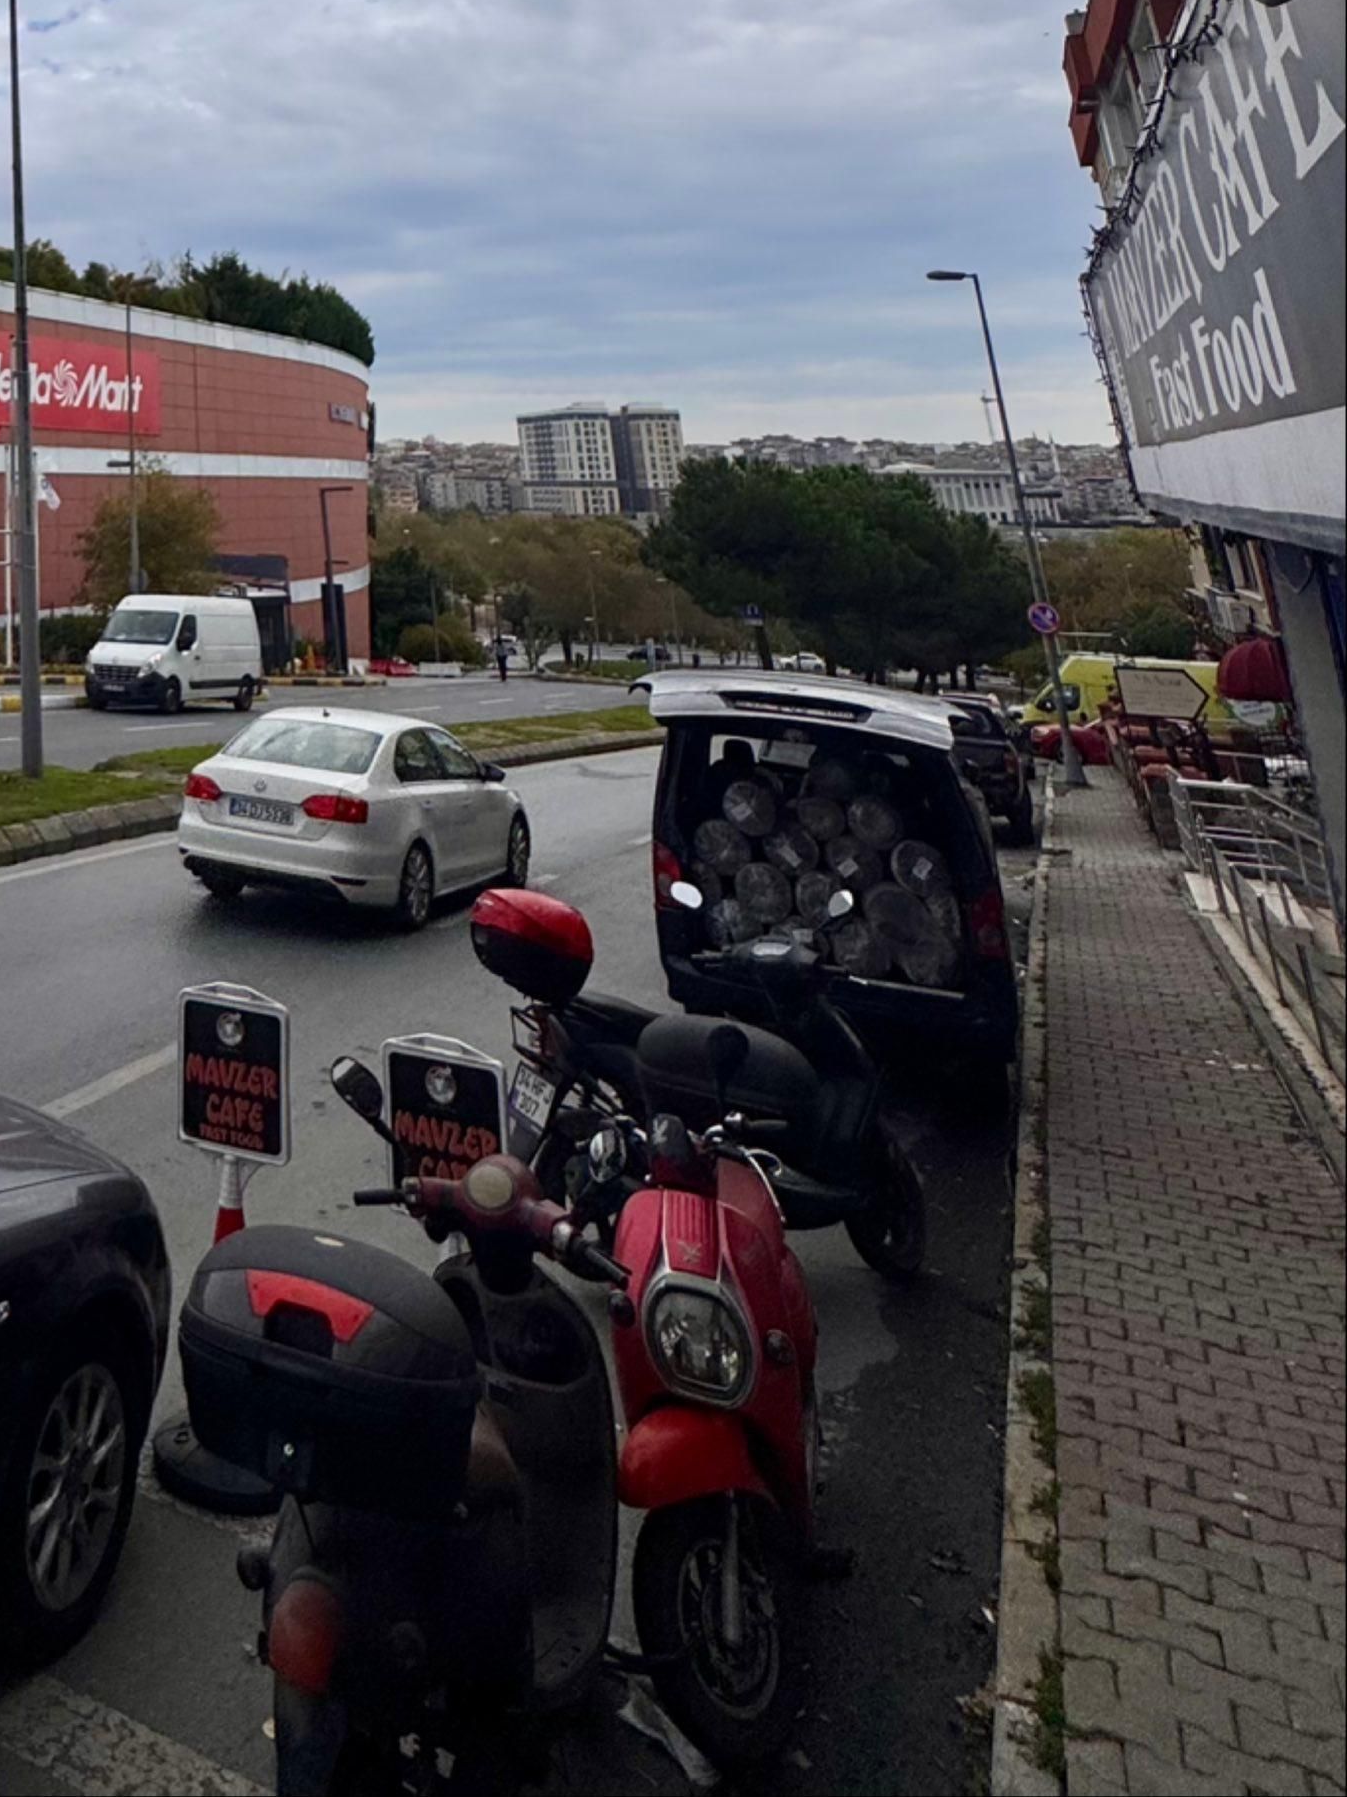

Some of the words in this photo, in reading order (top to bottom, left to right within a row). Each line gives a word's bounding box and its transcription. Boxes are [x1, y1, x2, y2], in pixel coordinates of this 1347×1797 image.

[1108, 159, 1203, 359] MAVZER
[1149, 344, 1203, 432] Fast
[1189, 268, 1296, 418] Food
[186, 1052, 278, 1100] MAVZER
[206, 1092, 264, 1133] CAFE
